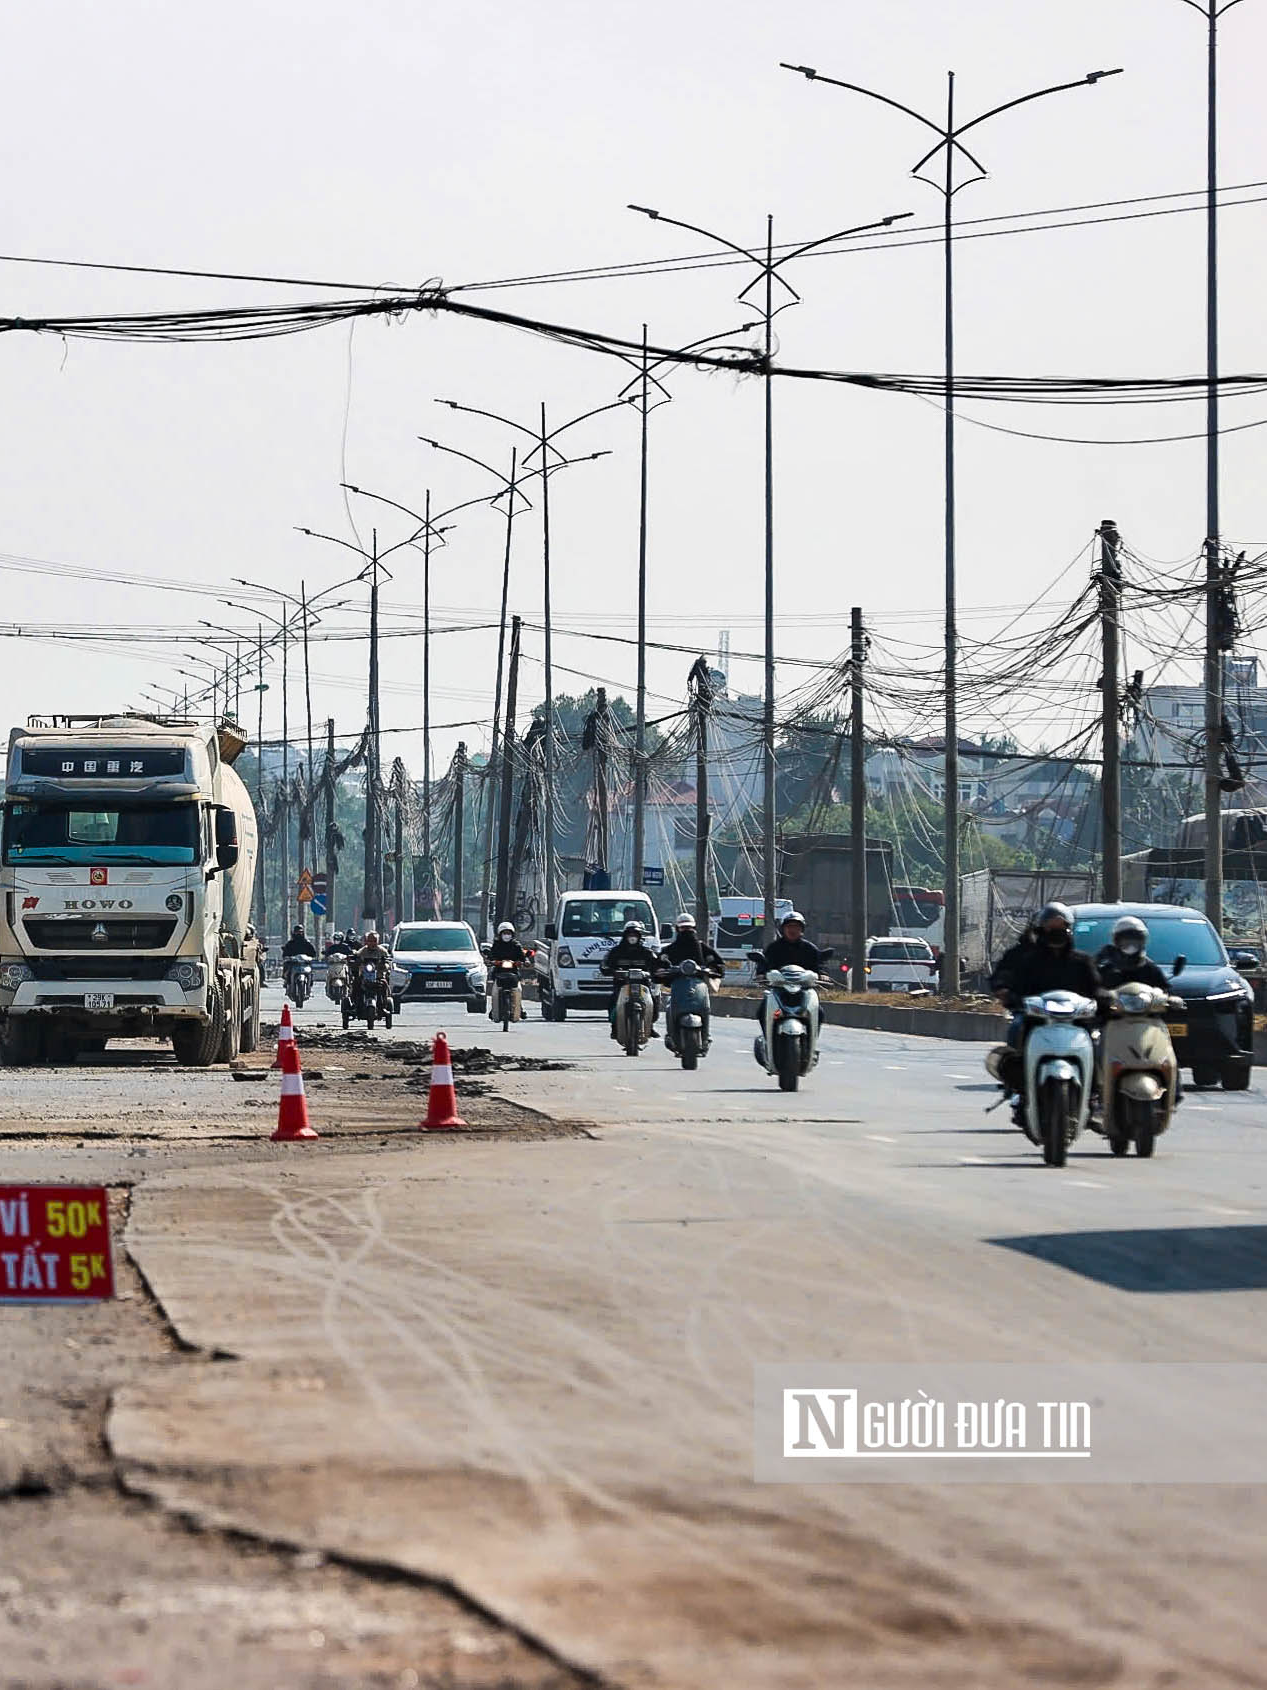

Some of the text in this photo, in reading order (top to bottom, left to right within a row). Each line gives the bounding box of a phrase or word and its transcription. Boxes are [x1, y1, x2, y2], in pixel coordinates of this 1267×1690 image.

[61, 760, 144, 773] 中国重汽
[64, 899, 133, 909] HOWO
[0, 1240, 60, 1289] TẤT
